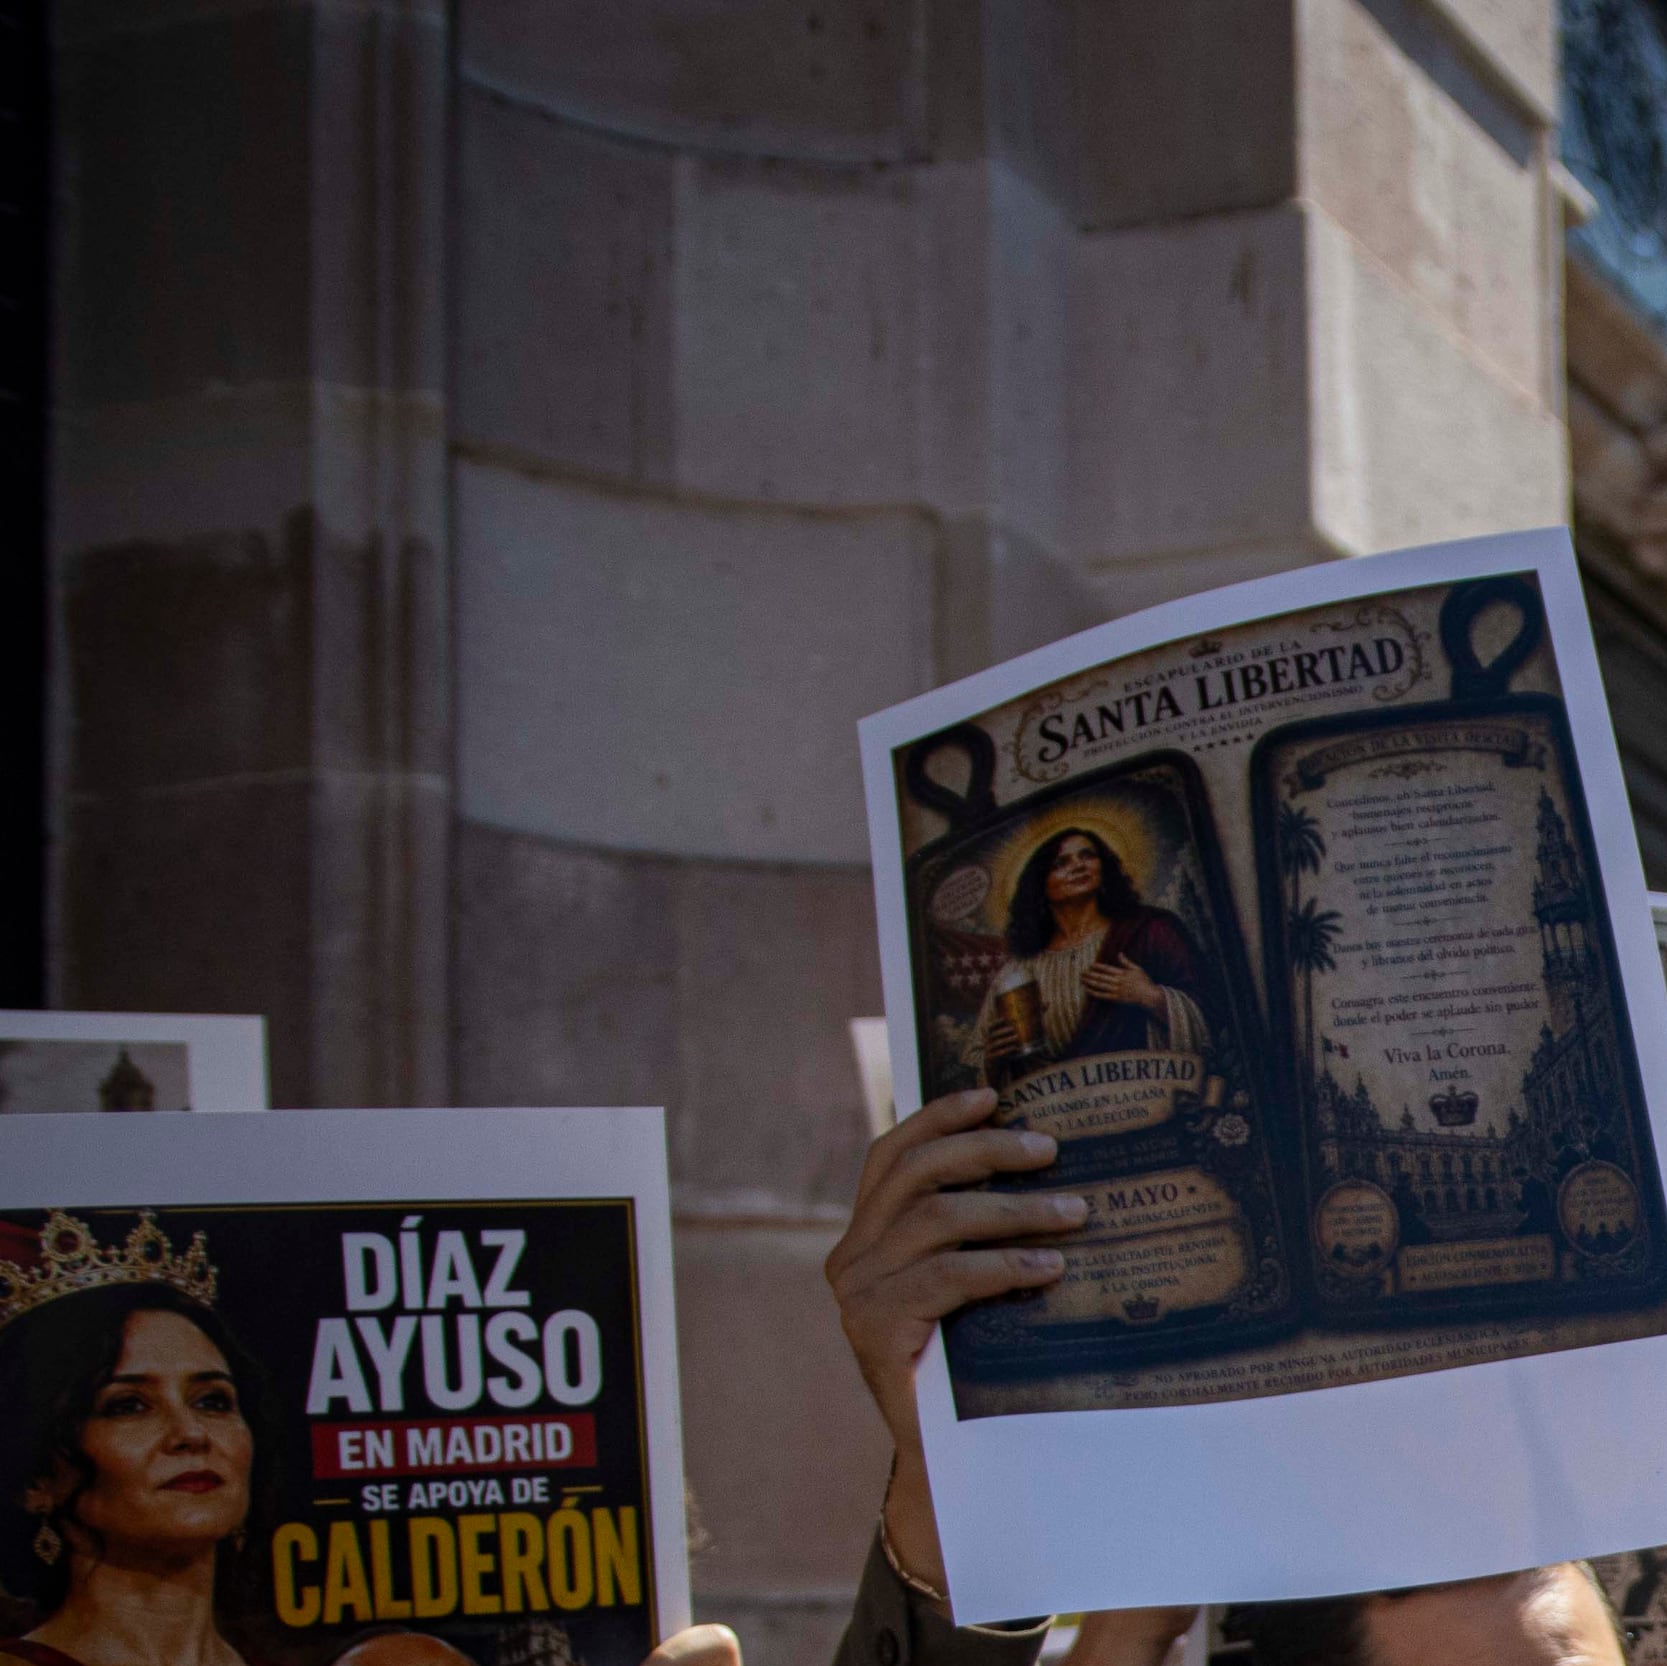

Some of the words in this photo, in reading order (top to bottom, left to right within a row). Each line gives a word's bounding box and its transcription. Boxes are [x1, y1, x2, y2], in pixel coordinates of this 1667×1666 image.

[1124, 652, 1244, 693] ESCAPULARIO
[1251, 645, 1273, 659] DE
[1282, 639, 1301, 653] LA
[1037, 684, 1185, 764] SANTA
[1198, 637, 1402, 710] LIBERTAD
[1164, 713, 1216, 735] CONTRA
[1219, 709, 1236, 721] EL
[1239, 686, 1362, 718] INTERVENCIONISMO
[1189, 727, 1207, 739] LA
[1210, 717, 1263, 737] ENVIDIA
[1392, 734, 1411, 747] LA
[1414, 787, 1444, 799] Santa
[1352, 804, 1411, 821] homenajes
[1342, 823, 1388, 839] aplausos
[1391, 820, 1414, 832] bien
[1334, 861, 1356, 874] Que
[1359, 858, 1391, 870] nunca
[1395, 853, 1417, 867] falte
[1420, 851, 1430, 863] el
[1353, 874, 1380, 886] entre
[1383, 870, 1422, 884] quienes
[1425, 869, 1436, 879] se
[1386, 880, 1446, 898] solemnidad
[1450, 879, 1462, 890] en
[1467, 876, 1493, 889] actos
[1366, 903, 1380, 916] de
[1386, 936, 1421, 949] nuestra
[1424, 931, 1474, 945] ceremonia
[1477, 926, 1489, 939] de
[1491, 925, 1514, 938] cada
[1417, 949, 1433, 962] del
[1436, 946, 1470, 961] olvido
[1331, 995, 1385, 1011] Consagra
[1388, 993, 1409, 1005] este
[1412, 988, 1469, 1002] encuentro
[1333, 1011, 1367, 1028] donde
[1370, 1010, 1380, 1023] el
[1384, 1006, 1418, 1026] poder
[1420, 1007, 1434, 1020] se
[1436, 1001, 1480, 1019] aplaude
[1484, 1000, 1503, 1014] sin
[1384, 1047, 1422, 1064] Viva
[1426, 1043, 1443, 1062] la
[1446, 1040, 1511, 1060] Corona.
[1081, 1058, 1195, 1087] LIBERTAD
[1428, 1067, 1472, 1082] Amén.
[1094, 1094, 1111, 1109] EN
[1114, 1091, 1131, 1105] LA
[1066, 1118, 1085, 1130] LA
[1108, 1182, 1179, 1211] MAYO
[1121, 1201, 1223, 1228] AGUASCALIENTES
[341, 1215, 531, 1312] DÍAZ
[1085, 1254, 1099, 1266] LA
[1102, 1249, 1151, 1265] LEALTAD
[1131, 1252, 1219, 1277] INSTITUCIONAL
[1111, 1281, 1128, 1294] LA
[1131, 1275, 1181, 1292] CORONA
[305, 1309, 602, 1415] AYUSO
[1124, 1389, 1159, 1402] PERO
[1161, 1379, 1260, 1398] CORDIALMENTE
[1263, 1370, 1325, 1388] RECIBIDO
[1328, 1367, 1354, 1381] POR
[1356, 1354, 1443, 1376] AUTORIDADES
[1446, 1337, 1530, 1361] MUNICIPALES
[1154, 1372, 1173, 1384] NO
[1177, 1365, 1246, 1382] APROBADO
[1249, 1362, 1275, 1375] POR
[1278, 1353, 1336, 1370] NINGUNA
[1341, 1341, 1412, 1363] AUTORIDAD
[337, 1429, 395, 1471] EN
[405, 1421, 574, 1467] MADRID
[361, 1483, 400, 1512] SE
[407, 1479, 504, 1510] APOYA
[511, 1476, 551, 1504] DE
[271, 1496, 643, 1628] CALDERÓN
